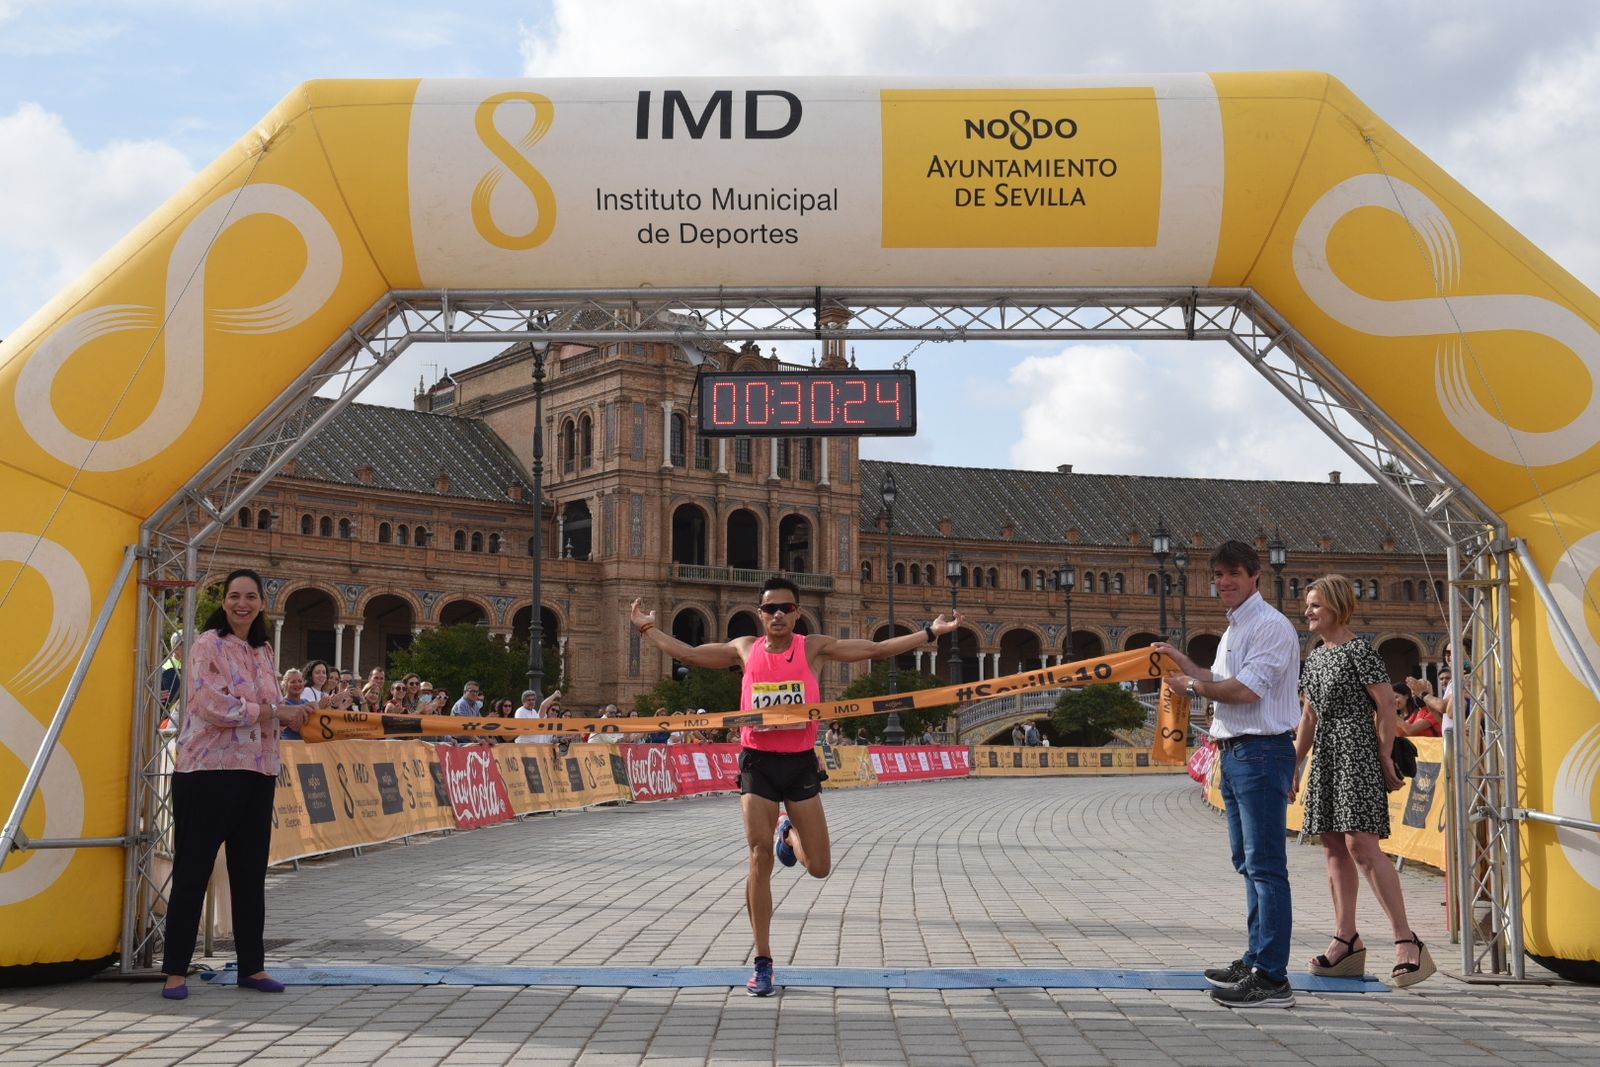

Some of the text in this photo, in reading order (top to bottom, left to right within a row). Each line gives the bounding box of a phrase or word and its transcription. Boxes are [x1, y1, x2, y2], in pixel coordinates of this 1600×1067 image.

[636, 90, 803, 140] IMD
[926, 155, 1118, 178] AYUNTAMIENTO
[596, 187, 838, 217] Instituto Municipal
[955, 183, 1086, 207] DE SEVILLA
[637, 223, 799, 249] de Deportes
[713, 381, 900, 424] 00:30:24
[834, 704, 860, 714] IMD
[684, 719, 709, 727] IMD
